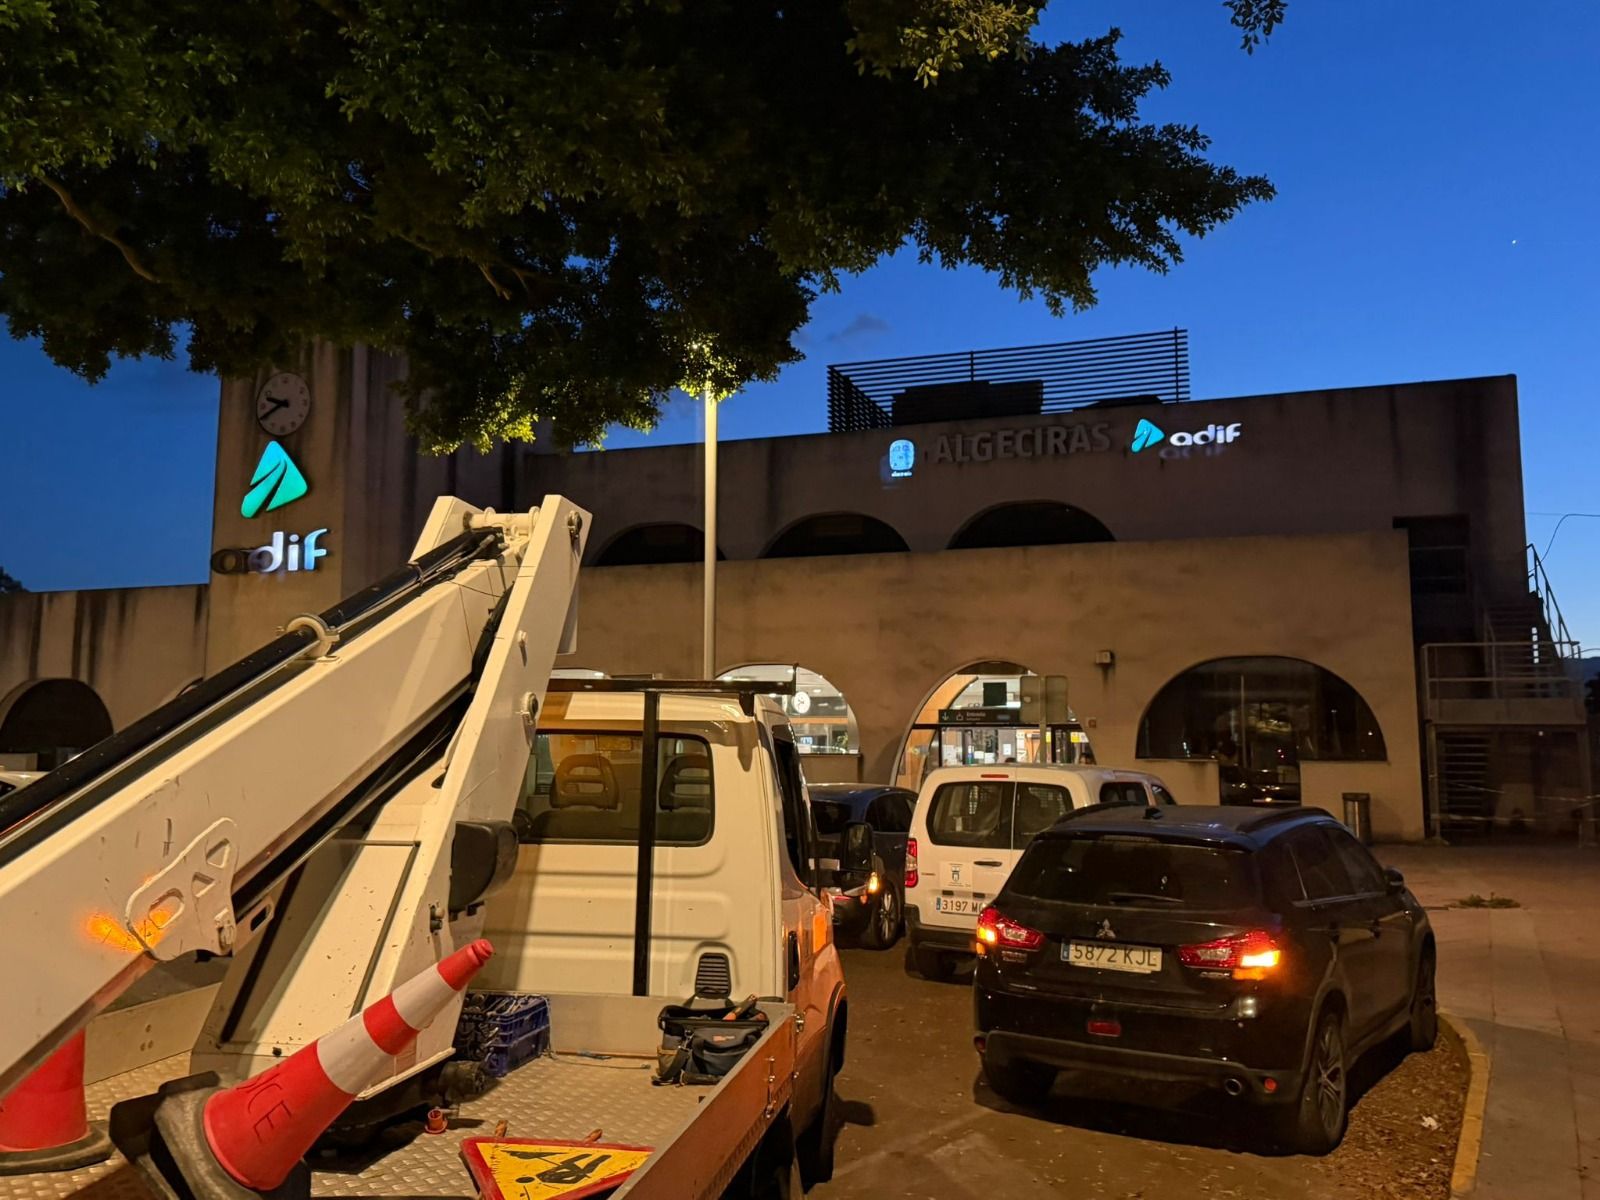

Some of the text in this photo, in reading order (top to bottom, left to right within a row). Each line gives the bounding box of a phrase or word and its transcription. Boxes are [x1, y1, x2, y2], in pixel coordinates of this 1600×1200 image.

[935, 423, 1110, 464] ALGECIRAS
[1169, 423, 1242, 447] adif
[211, 528, 329, 575] adif
[942, 899, 968, 912] 3197
[1074, 943, 1157, 967] 5872 KJL
